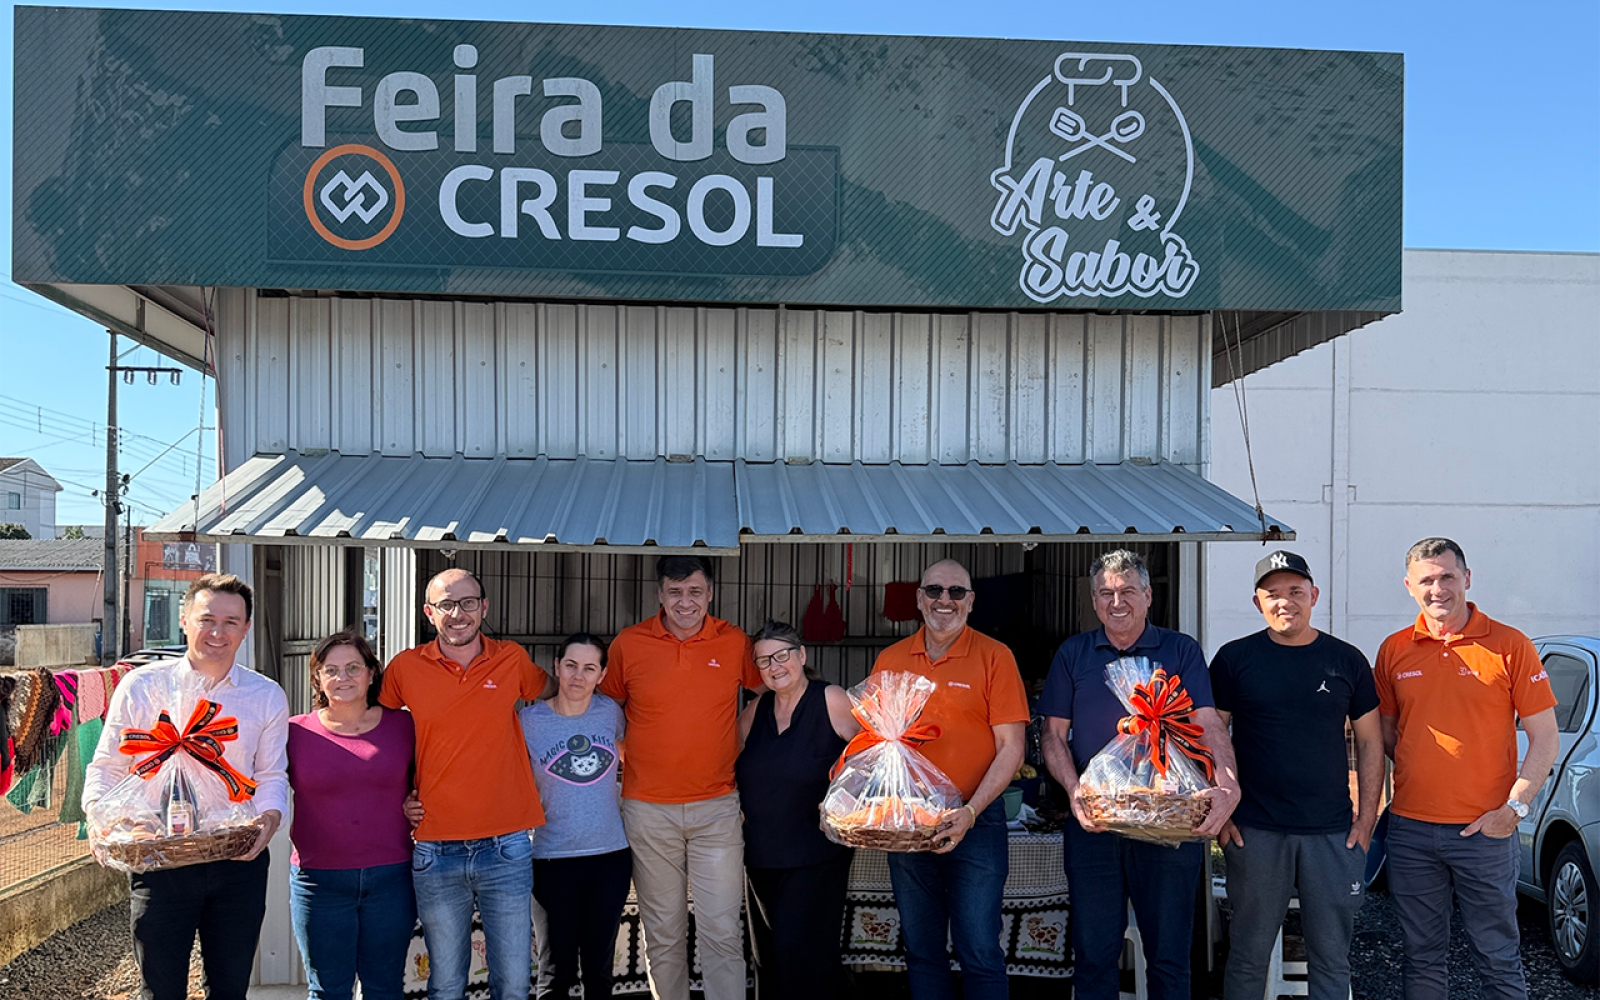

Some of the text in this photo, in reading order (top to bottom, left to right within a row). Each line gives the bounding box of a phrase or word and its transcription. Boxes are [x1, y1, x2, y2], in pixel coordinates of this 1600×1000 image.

[302, 43, 787, 165] Feira da
[438, 164, 804, 248] CRESOL
[998, 157, 1161, 231] Arte &
[1027, 225, 1193, 294] Sabor
[1270, 553, 1289, 568] NY
[540, 740, 565, 765] MAGIC
